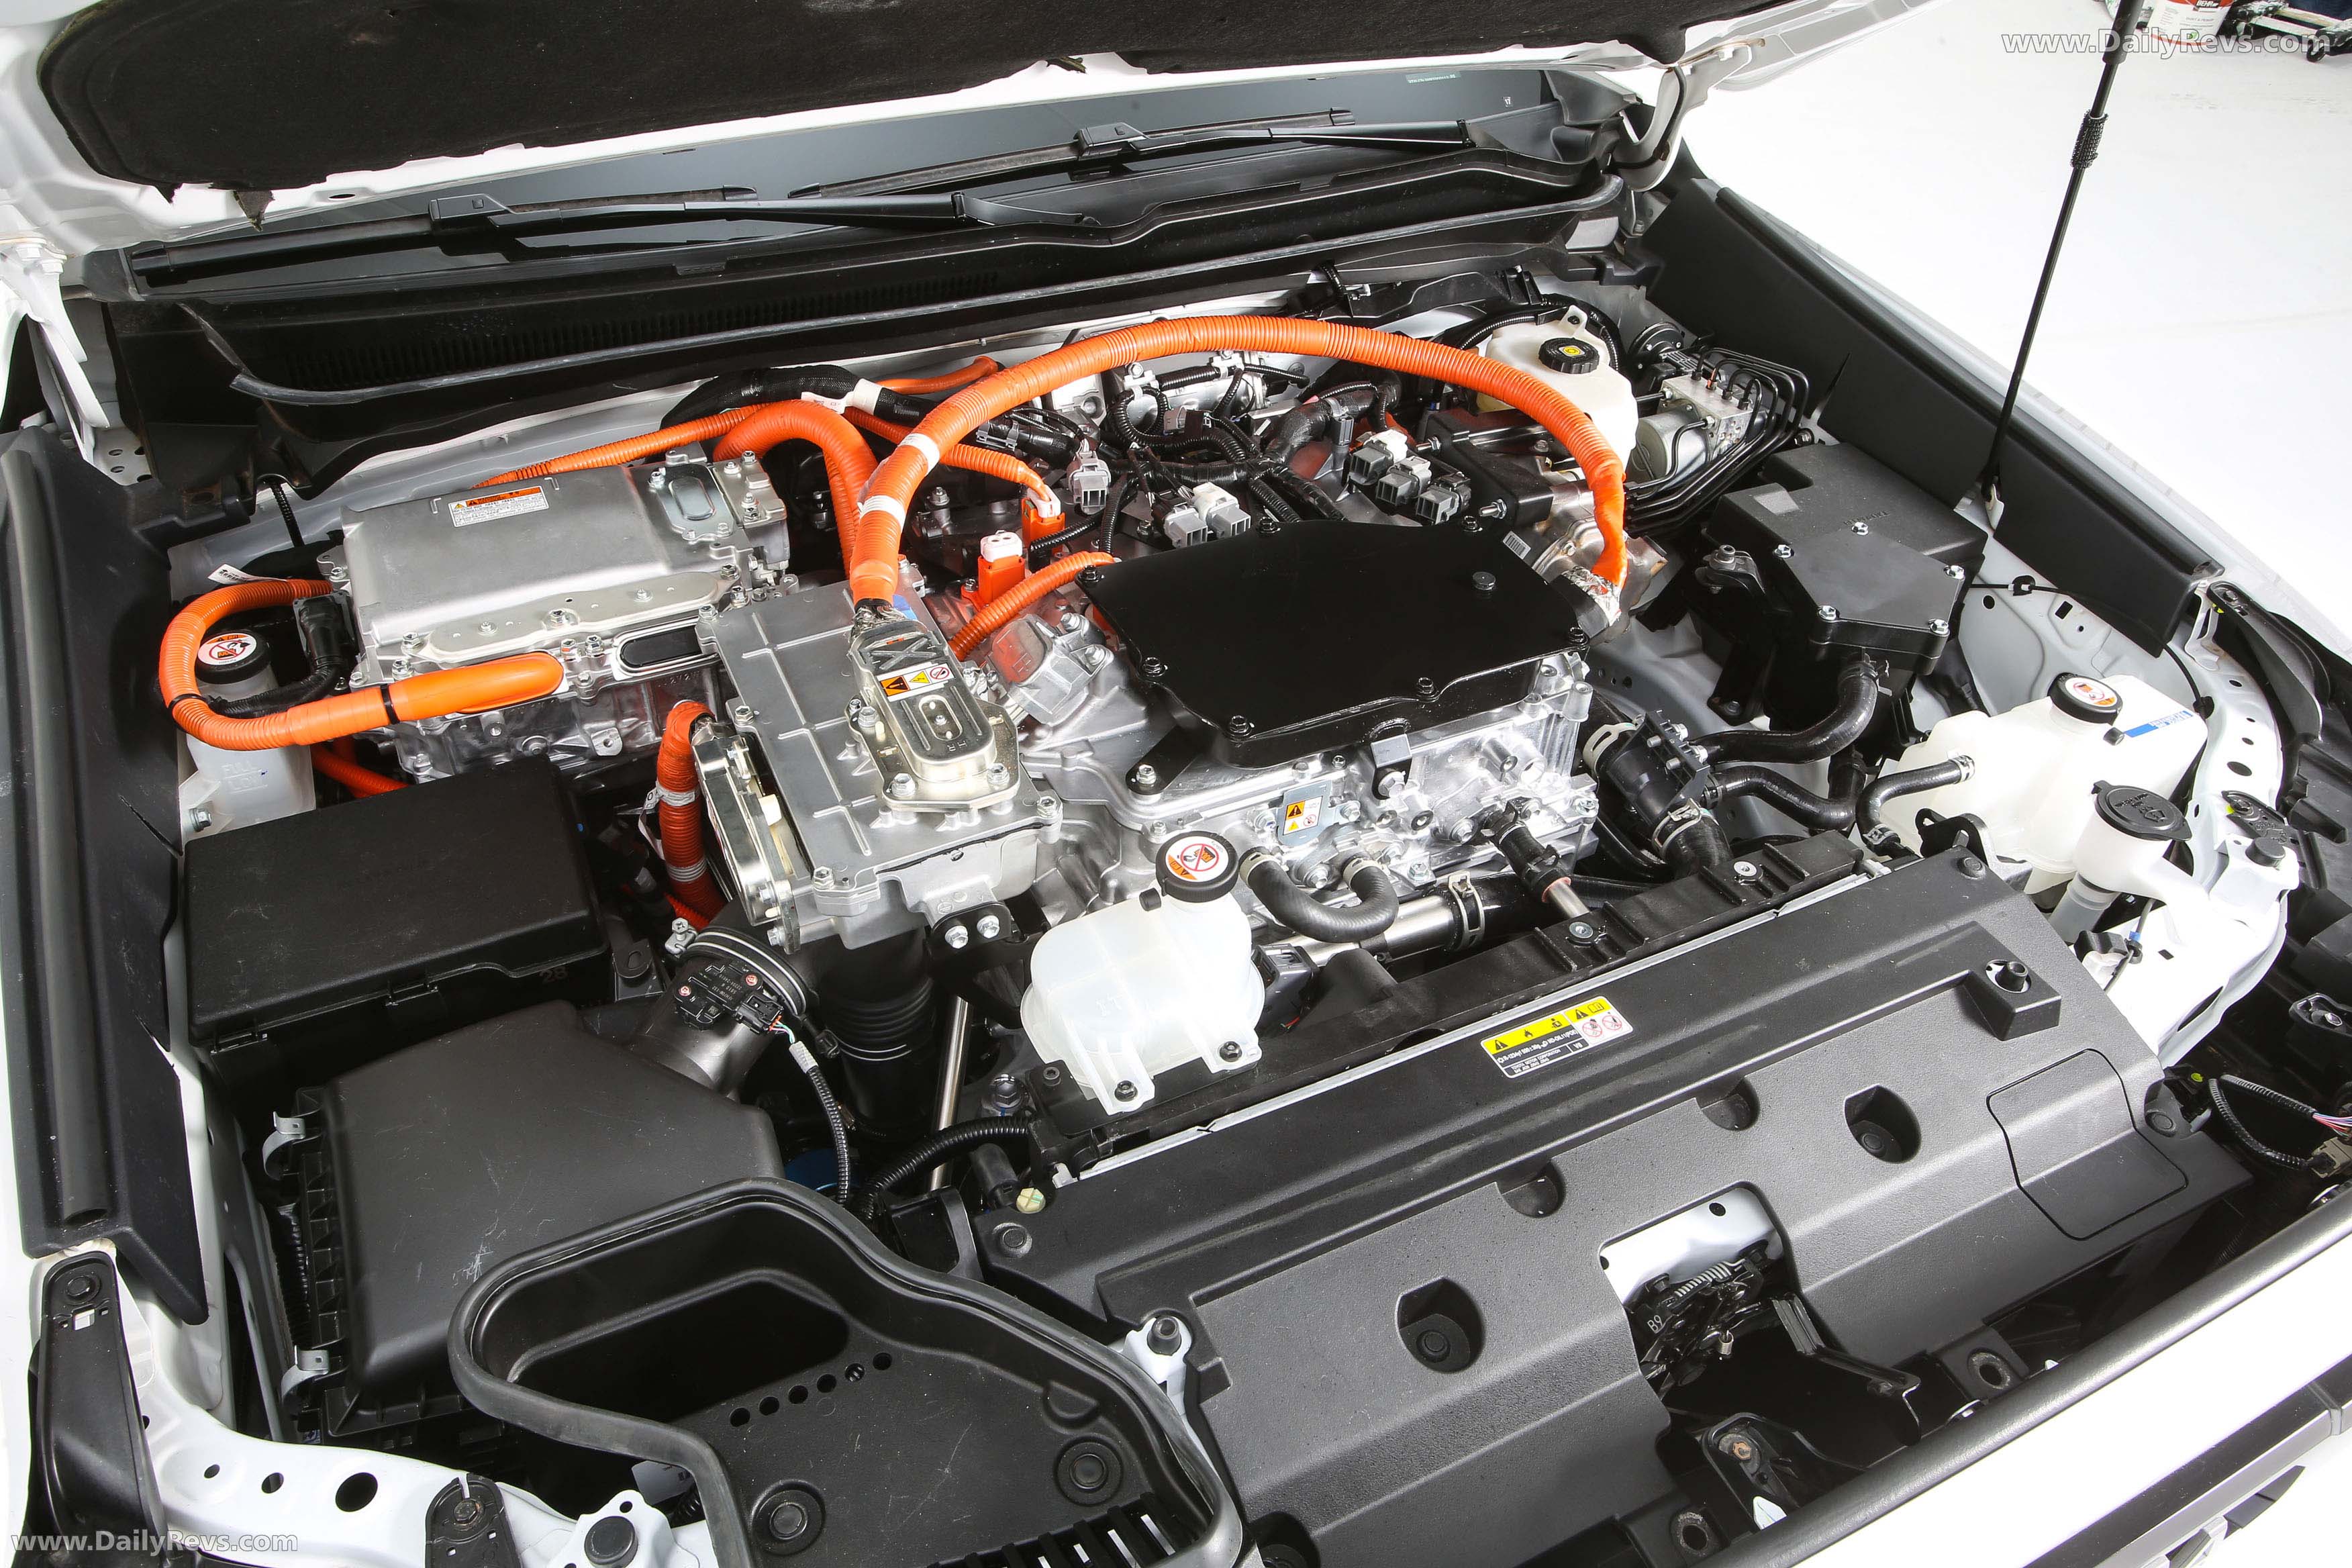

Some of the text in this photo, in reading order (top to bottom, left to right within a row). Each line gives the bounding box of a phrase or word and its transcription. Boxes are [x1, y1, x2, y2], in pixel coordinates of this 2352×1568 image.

[1524, 1057, 1538, 1065] MOTOR
[1537, 1048, 1561, 1061] CORPORATION
[1647, 1314, 1663, 1333] B9
